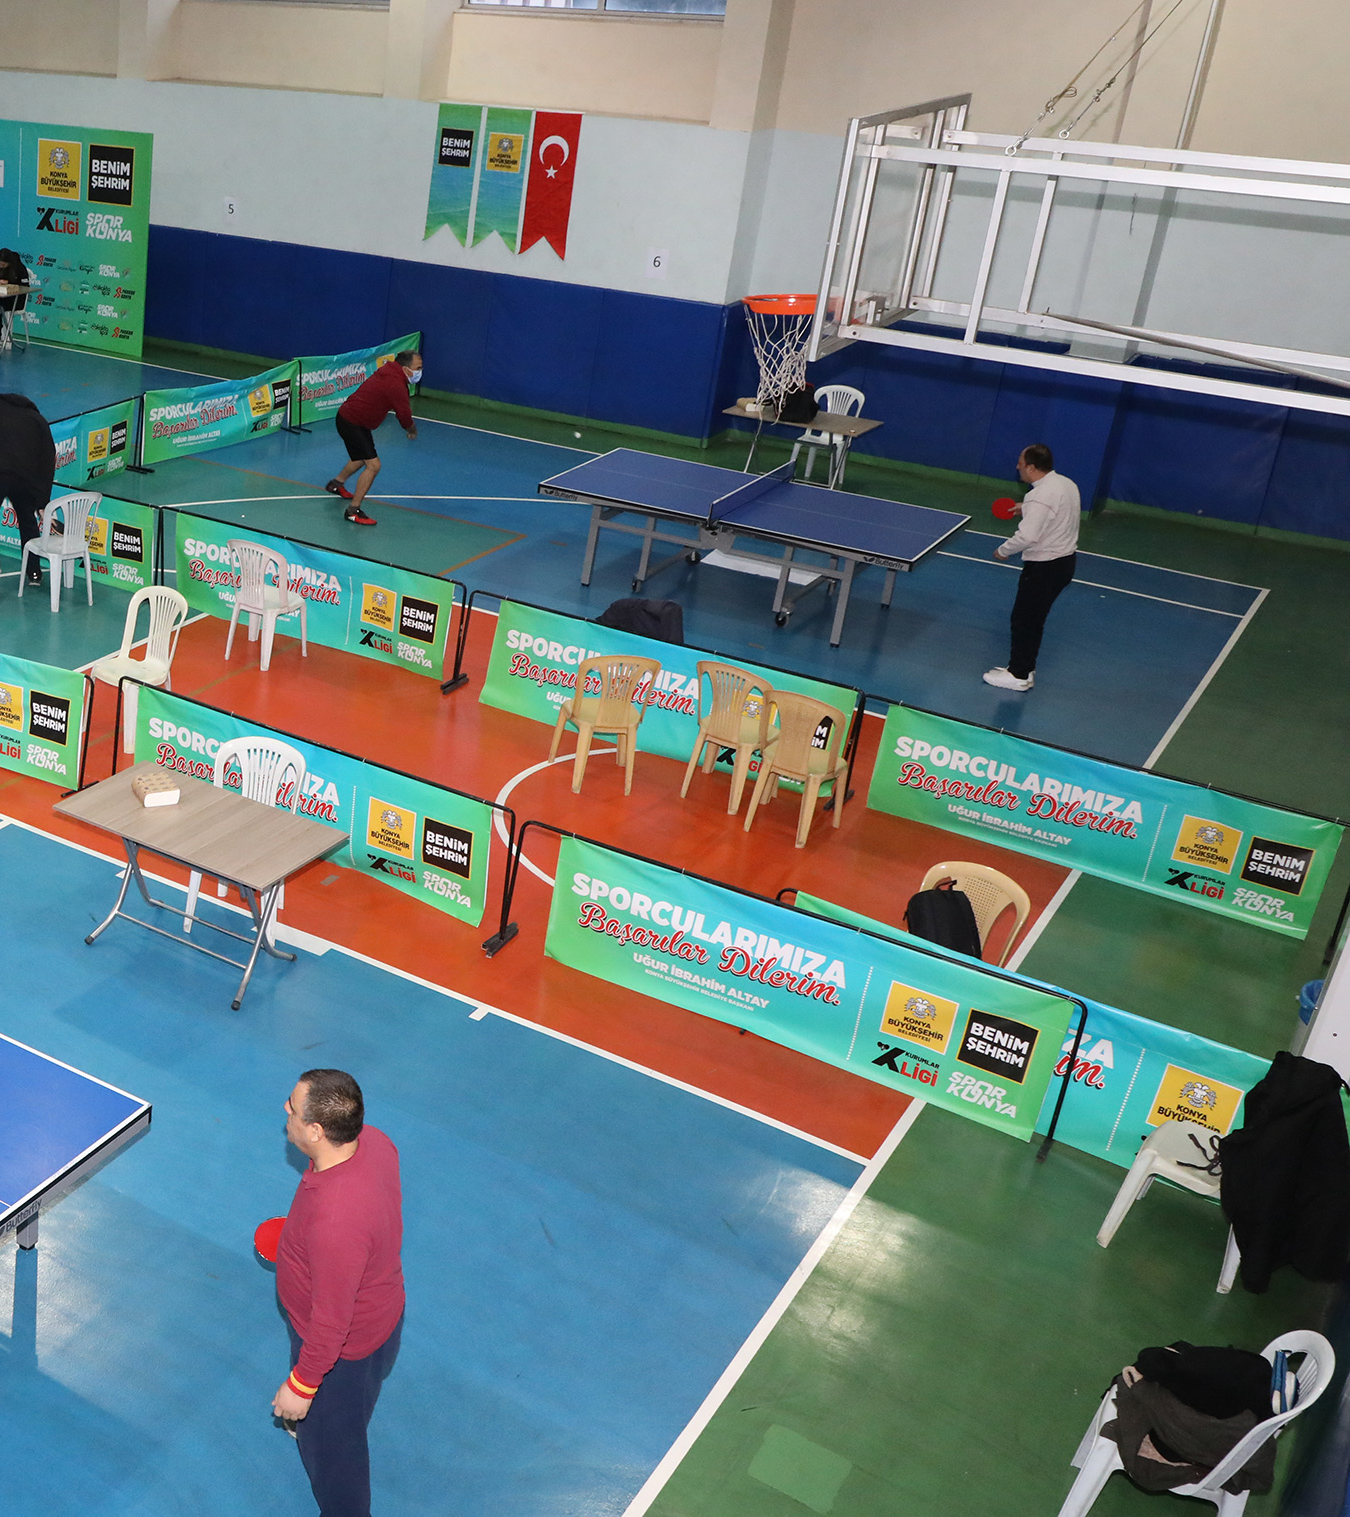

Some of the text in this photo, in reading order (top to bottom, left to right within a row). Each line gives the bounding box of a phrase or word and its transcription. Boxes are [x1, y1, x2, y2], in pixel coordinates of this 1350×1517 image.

[50, 170, 68, 180] KONYA
[228, 204, 234, 214] 5
[86, 212, 123, 229] SPOR
[87, 222, 132, 243] KONYA
[653, 256, 660, 268] 6
[27, 744, 60, 763] SPOR
[27, 755, 67, 775] KONYA
[894, 736, 1143, 825] SPORCULARIMIZA
[381, 828, 401, 839] KONYA
[1033, 828, 1072, 846] ALTAY
[1194, 843, 1219, 854] KONYA
[422, 872, 462, 893] SPOR
[423, 881, 471, 909] KONYA
[1233, 887, 1285, 909] SPOR
[1232, 895, 1295, 923] KONYA
[571, 872, 846, 990] SPORCULARIMIZA
[578, 902, 710, 964] Başarılar
[633, 952, 669, 973] UĞUR
[727, 988, 770, 1009] ALTAY
[903, 1016, 931, 1029] KONYA
[905, 1052, 940, 1069] KURUMLAR
[948, 1071, 1006, 1100] SPOR
[946, 1084, 1017, 1118] KONYA
[1177, 1105, 1207, 1122] KONYA
[6, 1199, 42, 1232] Butterfly
